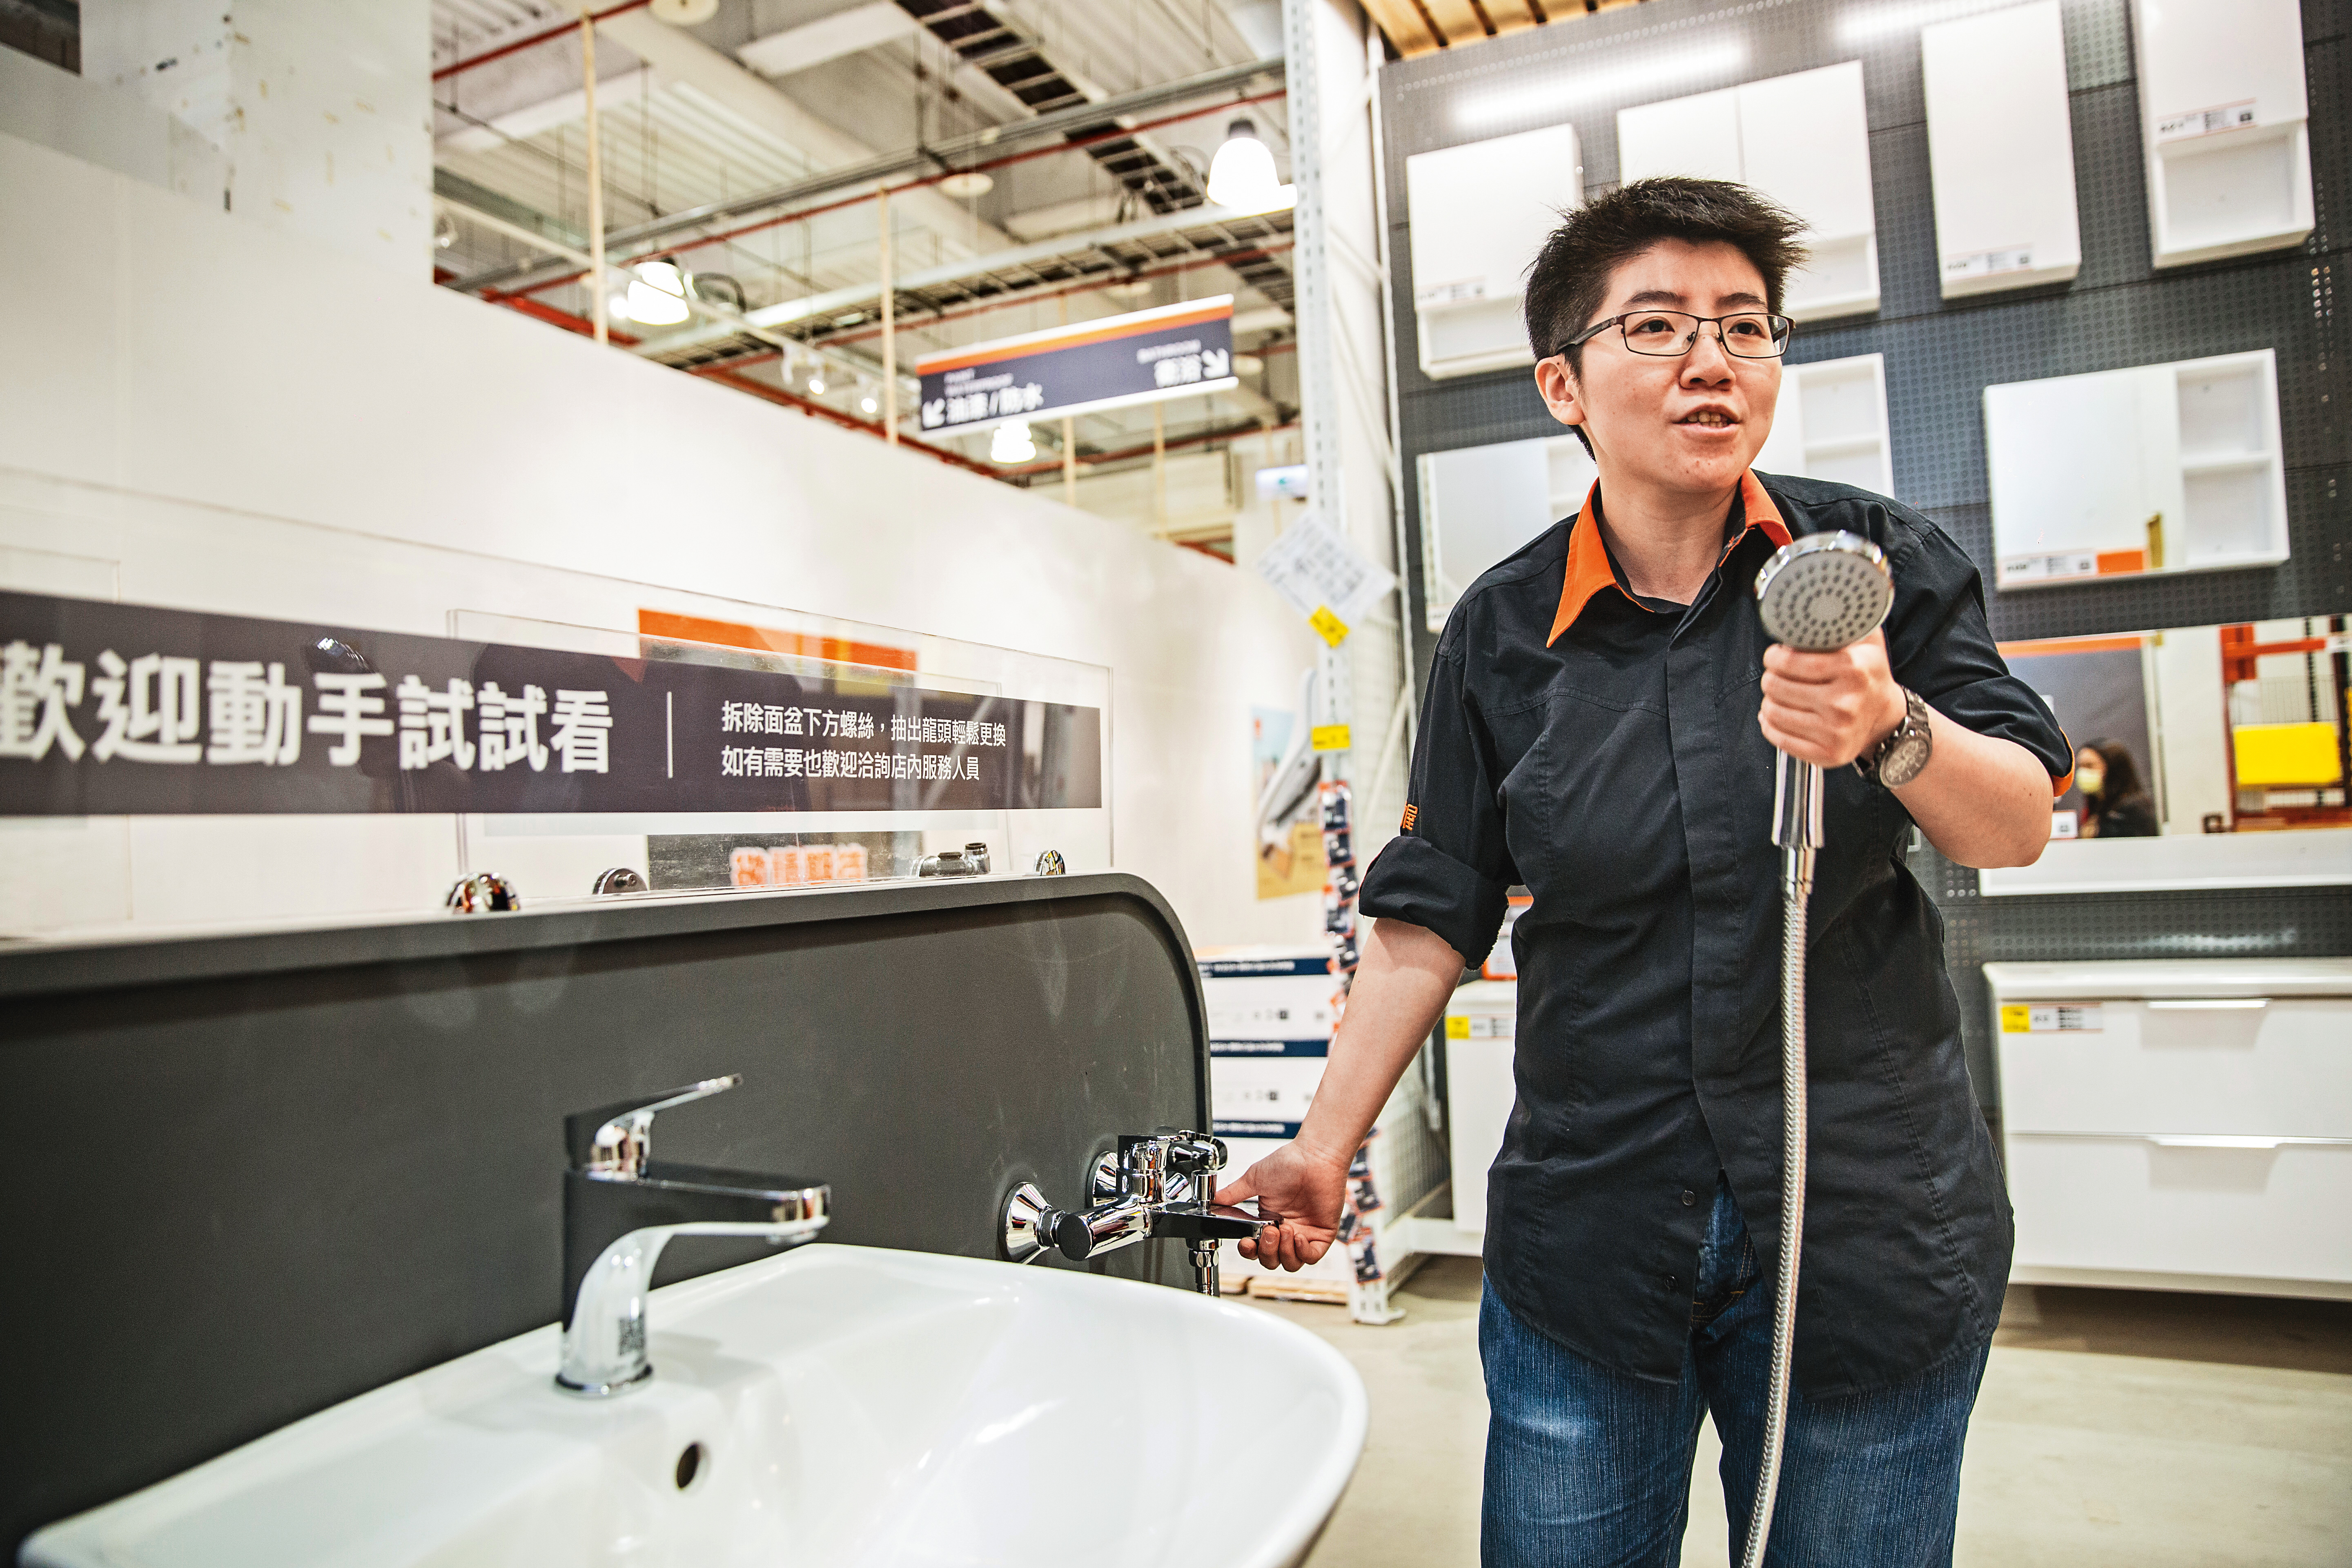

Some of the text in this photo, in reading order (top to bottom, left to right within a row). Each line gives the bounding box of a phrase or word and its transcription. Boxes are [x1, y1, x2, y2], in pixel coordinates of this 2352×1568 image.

[0, 640, 612, 773] 歡迎動手試試看
[722, 745, 980, 781] 如有需要也歡迎洽詢店內服務人員
